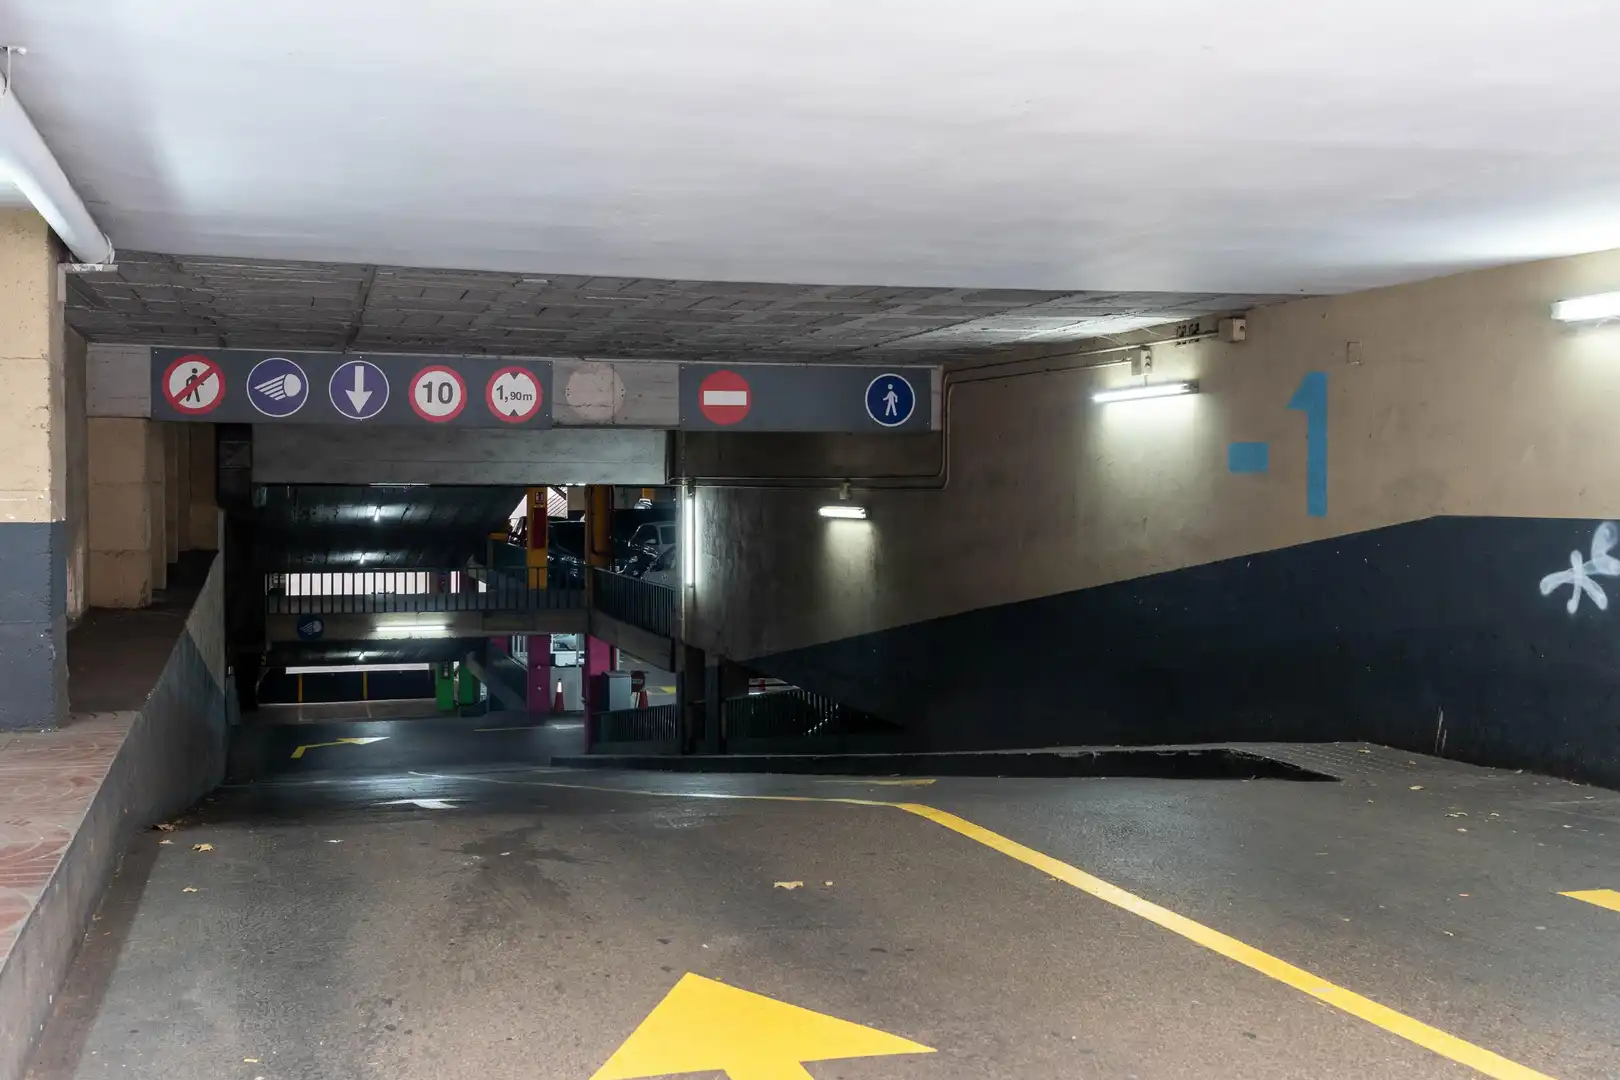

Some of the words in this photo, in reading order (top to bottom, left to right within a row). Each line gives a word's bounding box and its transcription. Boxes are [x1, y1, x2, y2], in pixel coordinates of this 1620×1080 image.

[422, 381, 454, 405] 10
[496, 385, 533, 403] 1,90m
[1228, 371, 1329, 517] -1
